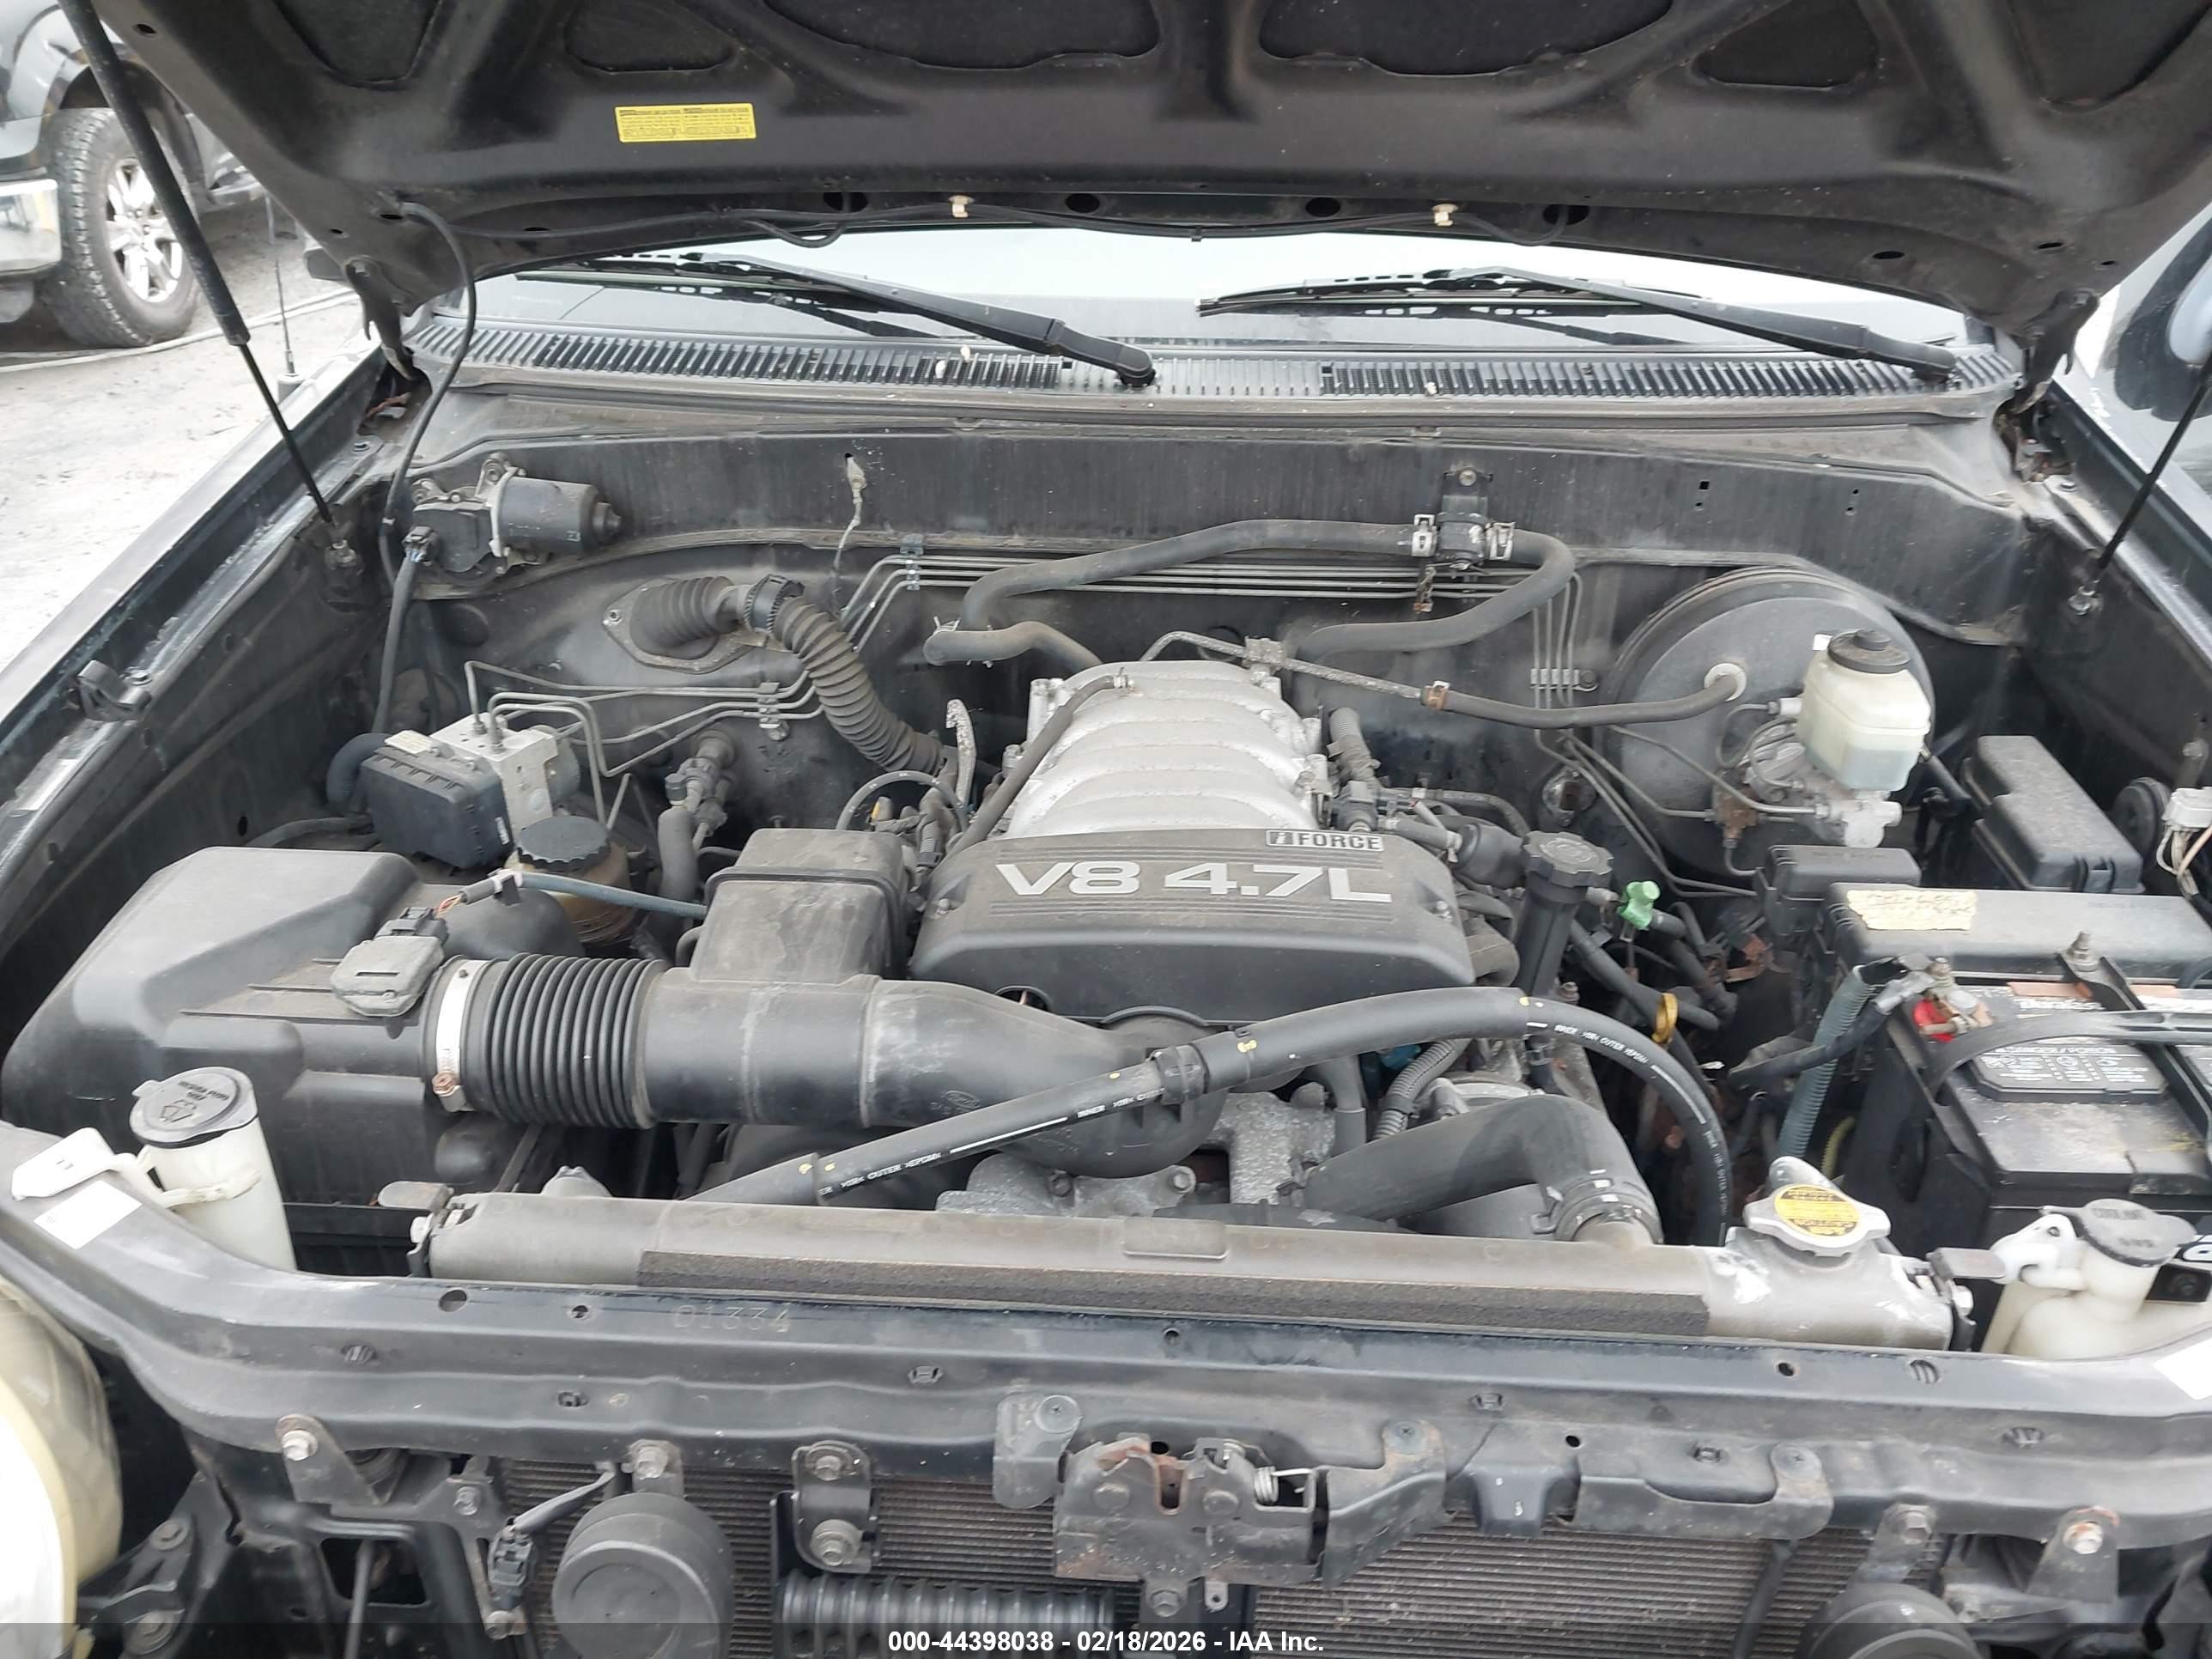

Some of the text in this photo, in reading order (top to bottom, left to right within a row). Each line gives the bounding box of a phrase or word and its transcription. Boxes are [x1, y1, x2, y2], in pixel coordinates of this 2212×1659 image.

[1297, 831, 1380, 849] FORCE
[995, 860, 1392, 902] V8 4.7L
